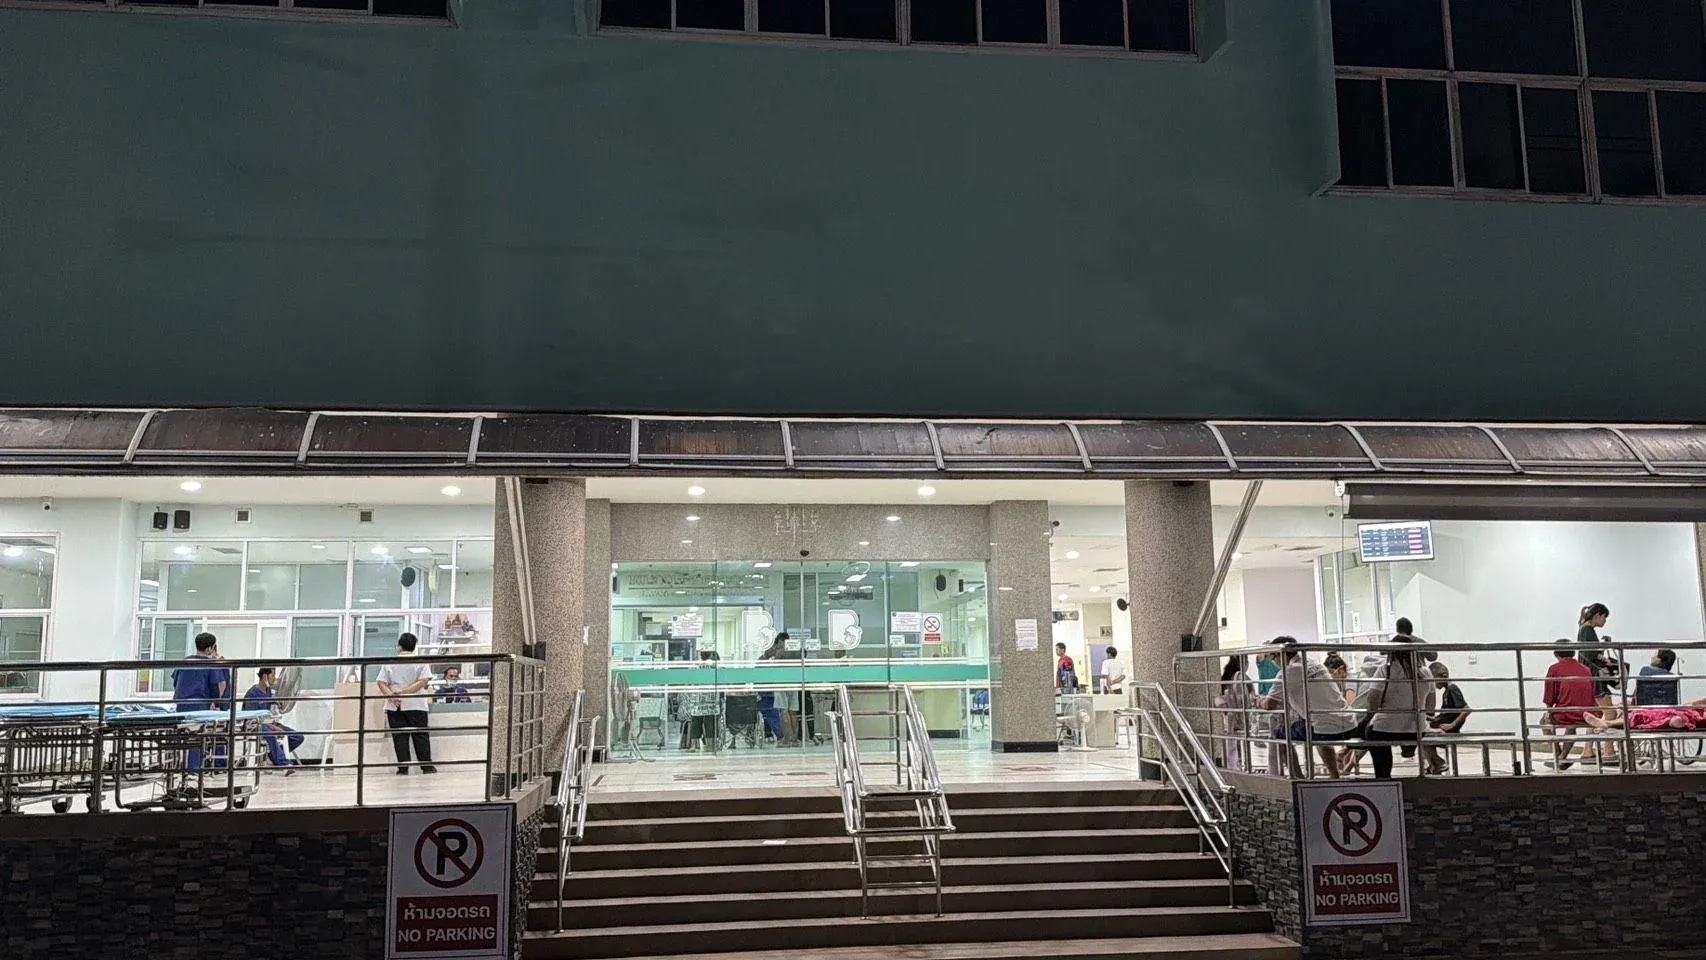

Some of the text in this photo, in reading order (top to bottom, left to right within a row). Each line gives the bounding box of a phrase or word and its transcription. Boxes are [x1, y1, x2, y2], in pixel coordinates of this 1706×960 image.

[1320, 870, 1393, 886] ห้ามจอดรถ
[1316, 892, 1399, 907] NO PARKING
[404, 903, 490, 920] ห้ามจอดรถ
[398, 927, 496, 943] NO PARKING
